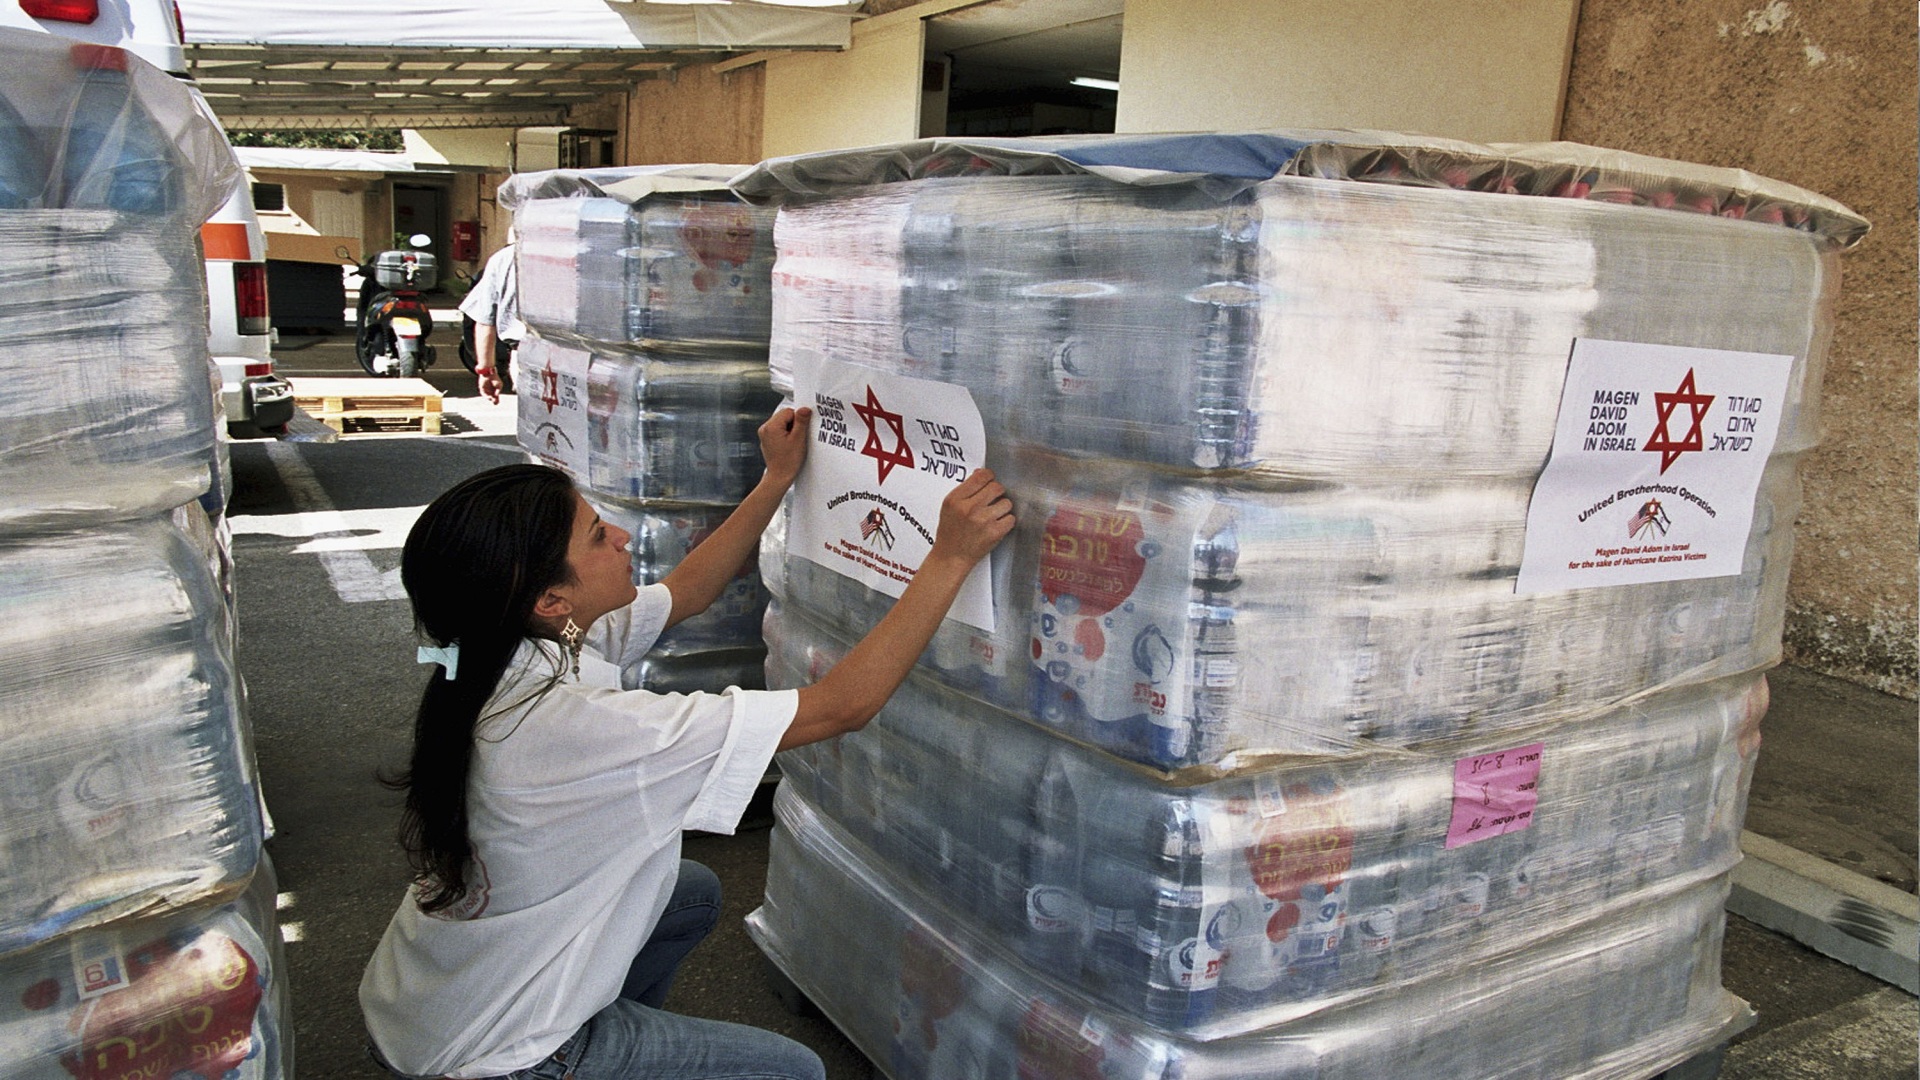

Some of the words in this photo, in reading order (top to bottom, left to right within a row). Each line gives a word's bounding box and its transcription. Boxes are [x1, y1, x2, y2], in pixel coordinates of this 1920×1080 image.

[1593, 390, 1640, 406] MAGEN
[1728, 396, 1745, 412] דוד
[1744, 397, 1762, 413] מגן
[817, 405, 843, 421] DAVID
[1590, 406, 1627, 420] DAVID
[820, 419, 847, 435] ADOM
[916, 419, 937, 436] דוד
[937, 423, 960, 441] מגן
[1587, 422, 1627, 436] ADOM
[1727, 416, 1756, 432] אדום
[817, 431, 829, 443] IN
[828, 434, 856, 452] ISRAEL
[1583, 437, 1597, 451] IN
[1599, 437, 1637, 451] ISRAEL
[1709, 432, 1752, 452] בישראל
[929, 439, 965, 462] אדום
[921, 452, 967, 482] בישראל
[1578, 494, 1614, 522] United
[1617, 483, 1678, 500] Brotherhood
[1678, 487, 1717, 518] Operation
[827, 492, 849, 510] United
[850, 490, 898, 511] Brotherhood
[899, 506, 935, 545] Operatio
[840, 538, 860, 552] Magen
[860, 546, 874, 559] David
[875, 553, 891, 567] Adom
[892, 558, 899, 570] in
[1595, 548, 1620, 558] Magen
[1620, 546, 1641, 555] David
[1641, 545, 1663, 554] Adom
[1663, 545, 1671, 553] in
[1672, 543, 1690, 552] Israel
[824, 542, 833, 551] for
[833, 546, 841, 556] the
[842, 550, 855, 561] sake
[856, 555, 862, 563] of
[862, 559, 888, 577] Hurricane
[888, 570, 911, 585] Katrin
[1568, 561, 1580, 570] for
[1582, 560, 1595, 569] the
[1596, 558, 1613, 568] sake
[1614, 557, 1622, 566] of
[1623, 556, 1657, 566] Hurricane
[1658, 554, 1683, 563] Katrina
[1684, 552, 1707, 561] Victims
[84, 964, 105, 984] 6
